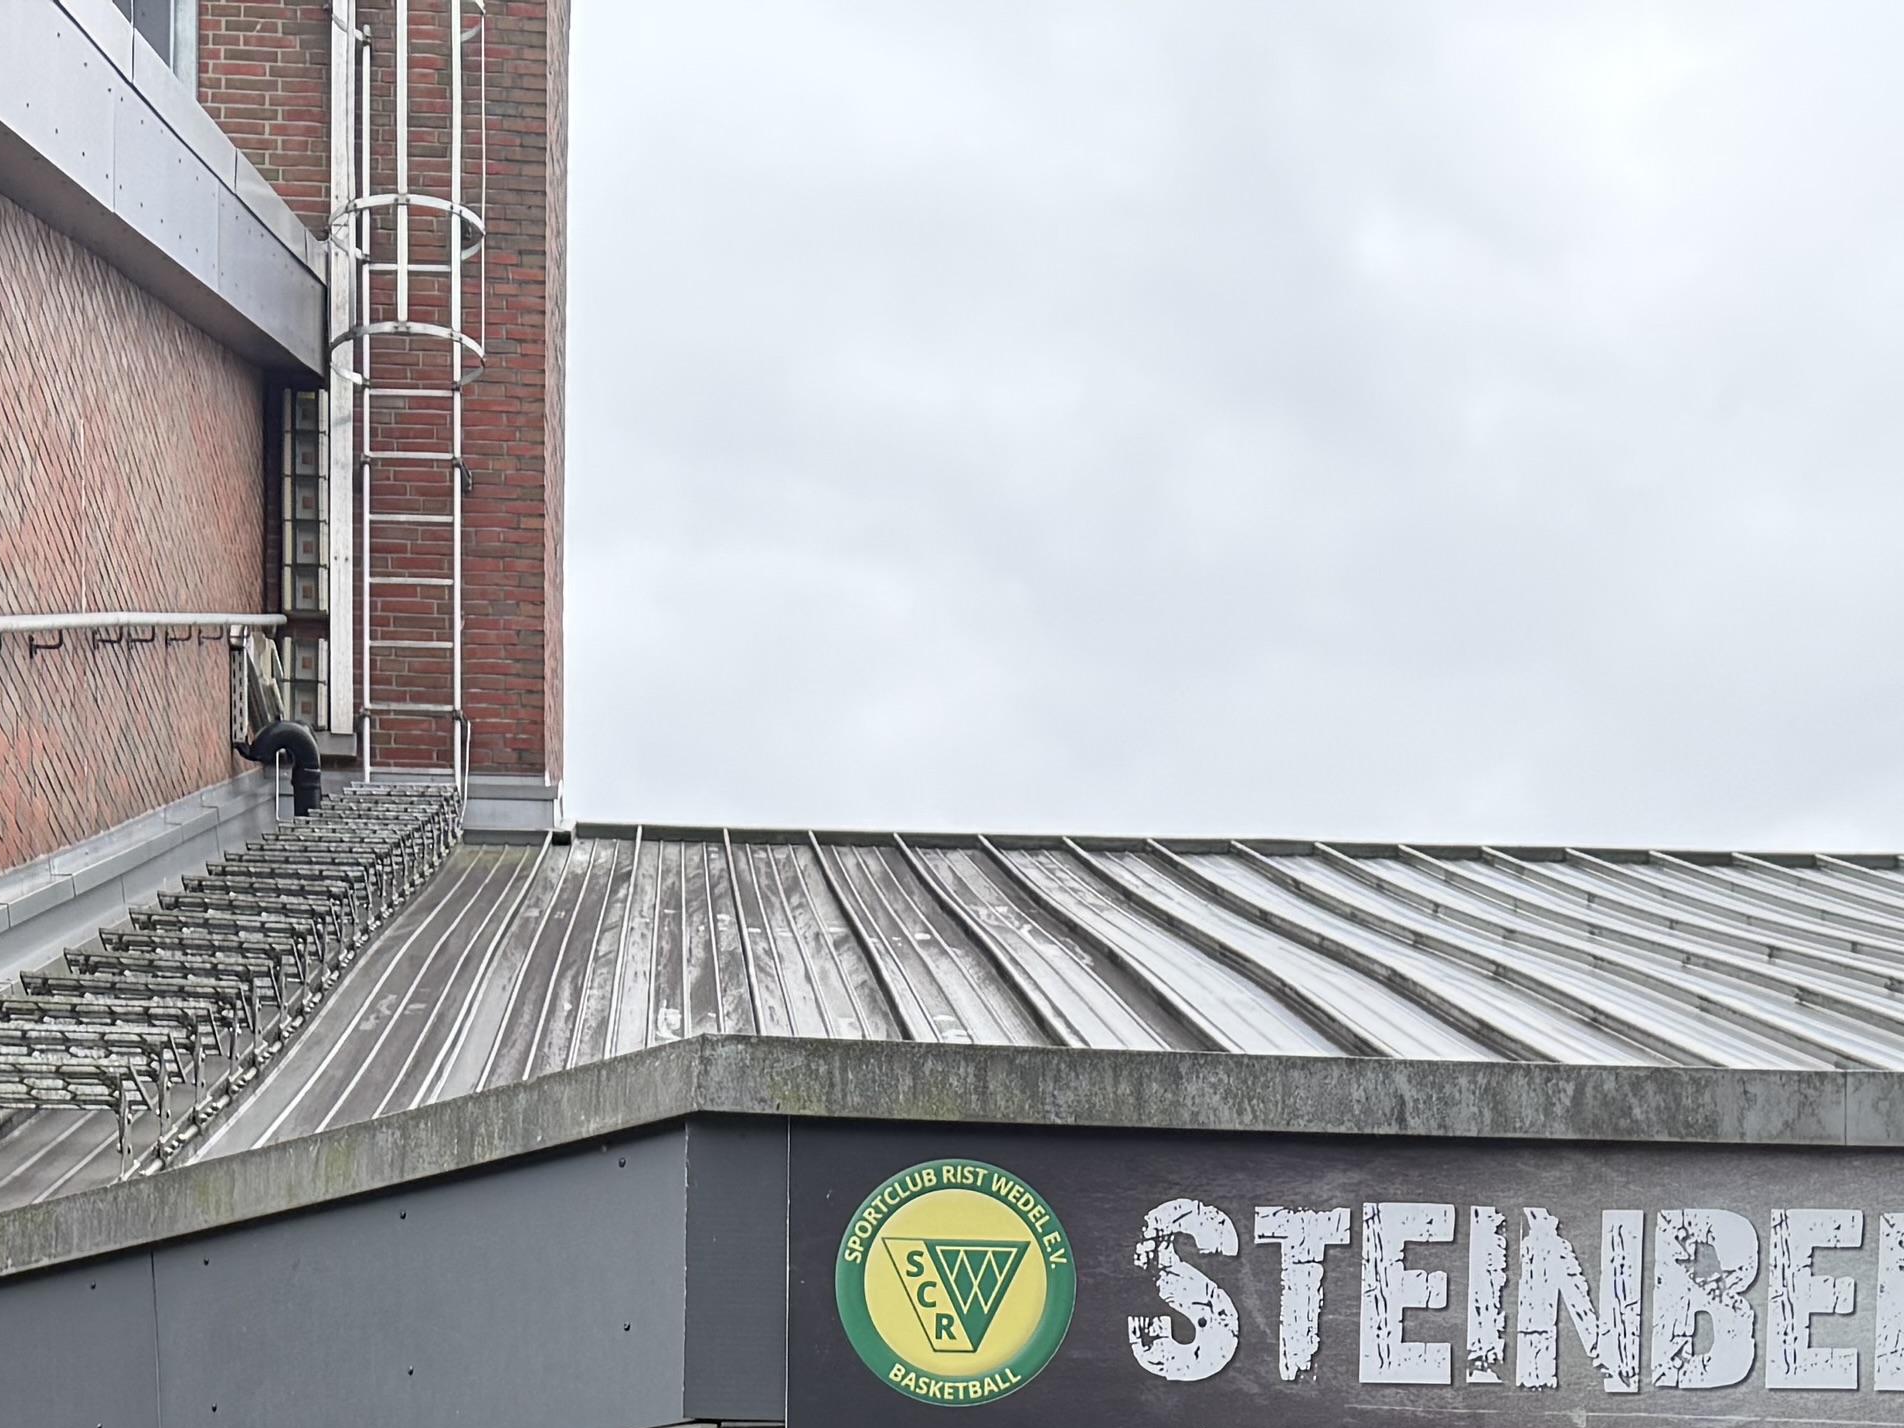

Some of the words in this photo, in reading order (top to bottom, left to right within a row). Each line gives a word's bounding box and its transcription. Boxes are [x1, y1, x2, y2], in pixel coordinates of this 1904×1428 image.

[844, 1168, 937, 1264] SPORTCLUB
[942, 1165, 988, 1185] RIST
[992, 1173, 1050, 1233] WEDEL
[1042, 1230, 1068, 1270] E.V.
[888, 1363, 1022, 1400] BASKETBALL
